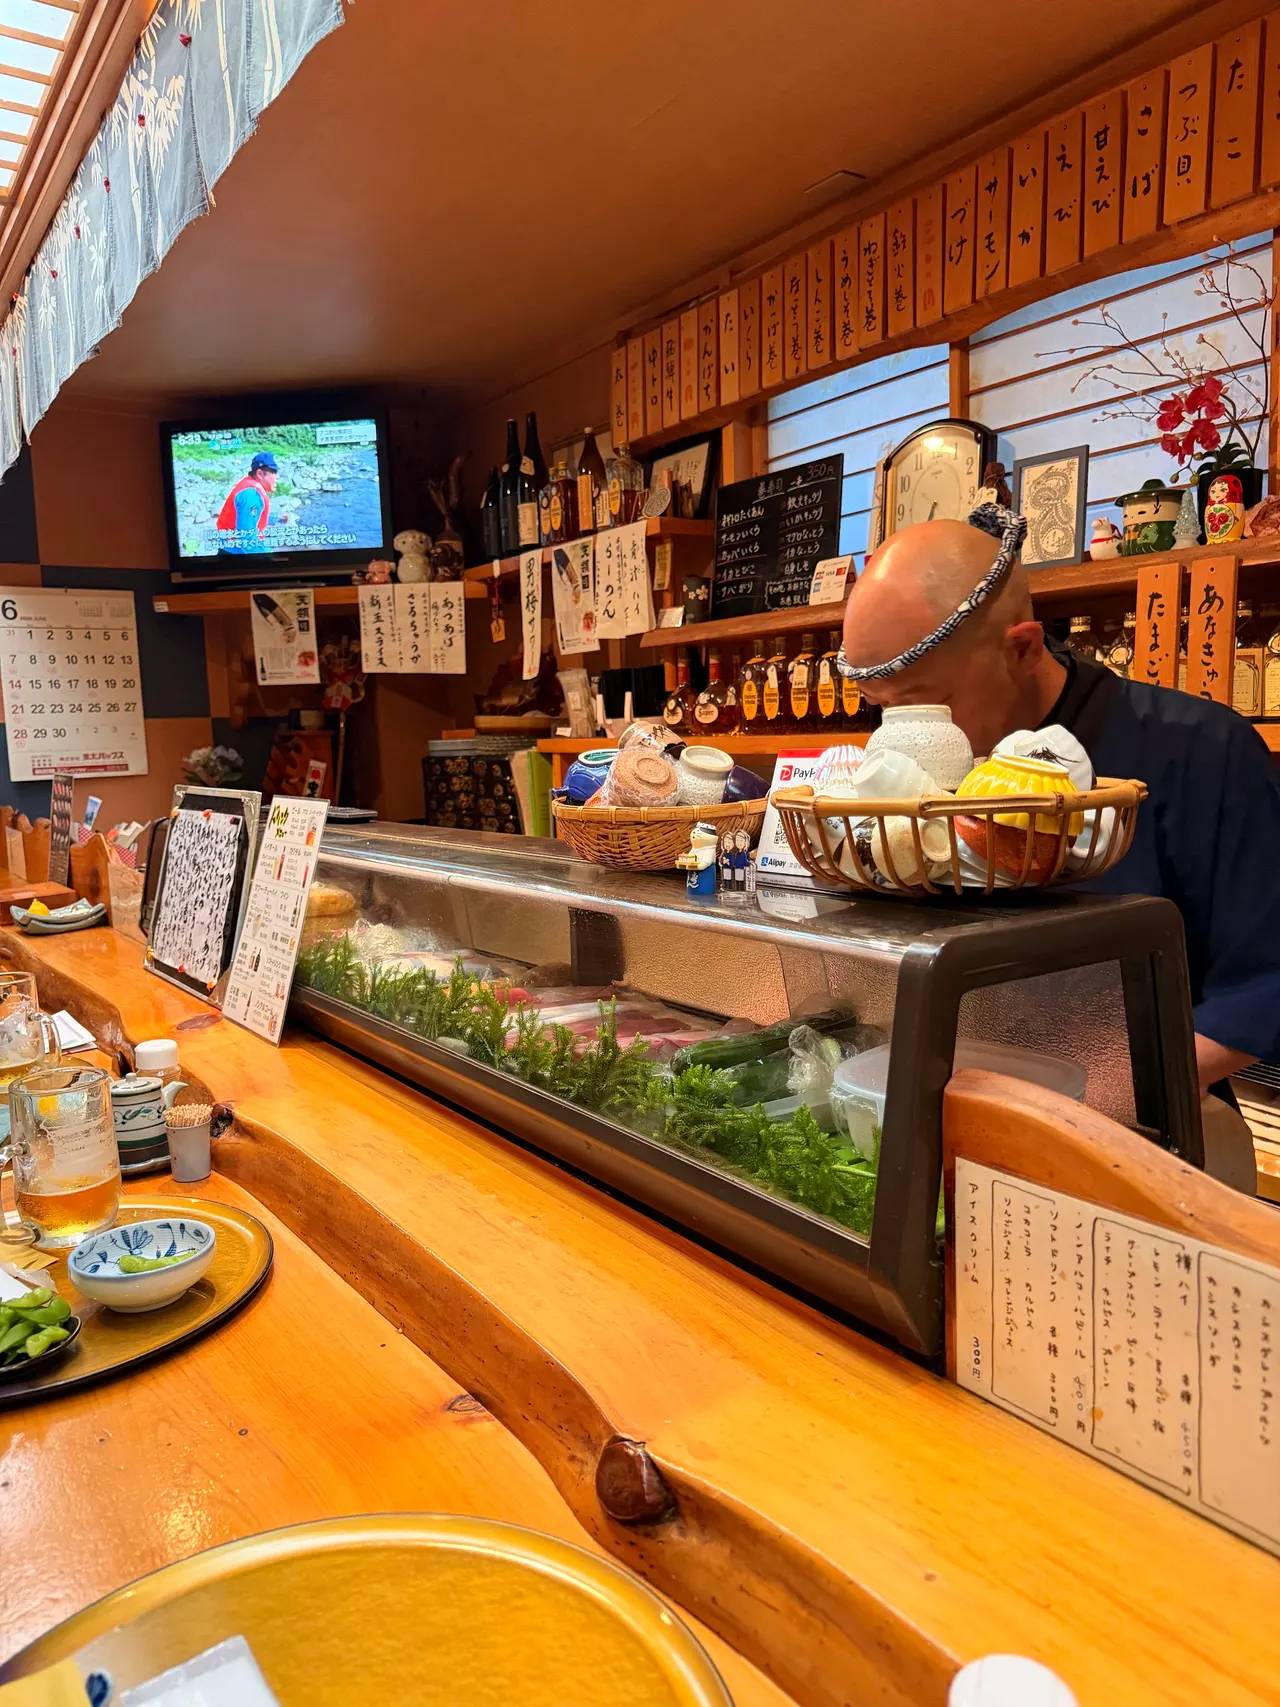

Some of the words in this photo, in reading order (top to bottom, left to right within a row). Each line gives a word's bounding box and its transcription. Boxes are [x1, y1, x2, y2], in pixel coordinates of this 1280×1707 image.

[1227, 58, 1245, 159] たこ
[1175, 83, 1200, 186] つぶ貝
[1053, 144, 1078, 222] えび
[1092, 124, 1116, 214] 甘えび
[984, 176, 1000, 280] サーモン
[1018, 167, 1038, 245] いか
[949, 198, 972, 265] づけ
[891, 227, 907, 312] 鉄火巻
[813, 266, 825, 354] しんこ巻
[840, 249, 854, 347] うめしそ巻
[723, 312, 736, 375] たい
[743, 306, 755, 371] いくら
[766, 288, 779, 370] かっぱ巻
[702, 317, 714, 402] かんぱち
[179, 433, 202, 446] 6:33
[953, 443, 959, 460] 1
[899, 474, 911, 493] 10
[914, 453, 924, 472] 11
[965, 457, 974, 475] 2
[897, 504, 905, 521] 9
[968, 487, 976, 504] 3
[720, 524, 760, 545] サーモンいくら
[720, 542, 760, 561] カッパいくら
[785, 525, 824, 543] マグロなっとう
[602, 540, 616, 619] らーめん
[784, 560, 809, 575] 白身しそ
[1, 599, 18, 620] 6
[441, 597, 454, 648] あつあげ
[27, 631, 33, 640] 1
[47, 630, 54, 640] 2
[66, 631, 73, 640] 3
[84, 631, 92, 640] 4
[103, 631, 111, 641] 5
[121, 631, 129, 641] 6
[9, 655, 17, 664] 7
[29, 655, 37, 665] 8
[48, 655, 56, 664] 9
[65, 655, 78, 665] 10
[83, 655, 96, 665] 11
[102, 655, 115, 665] 12
[120, 655, 133, 665] 13
[8, 680, 22, 689] 14
[28, 680, 42, 689] 15
[47, 680, 61, 689] 16
[67, 680, 79, 689] 17
[85, 680, 99, 689] 18
[104, 679, 117, 689] 19
[122, 679, 136, 688] 20
[11, 704, 24, 714] 21
[30, 704, 45, 714] 22
[50, 704, 64, 714] 23
[69, 704, 83, 713] 24
[87, 703, 102, 713] 25
[106, 703, 120, 712] 26
[124, 702, 137, 712] 27
[13, 729, 28, 739] 28
[33, 729, 47, 738] 29
[52, 728, 66, 738] 30
[793, 767, 816, 780] PayP
[768, 858, 787, 868] Alipay
[968, 1181, 980, 1285] アイスクリーム
[1048, 1207, 1059, 1303] ソフトドリンク
[1073, 1220, 1086, 1359] ノンアルコールビール
[972, 1336, 981, 1380] 300円
[1049, 1372, 1059, 1419] 300円
